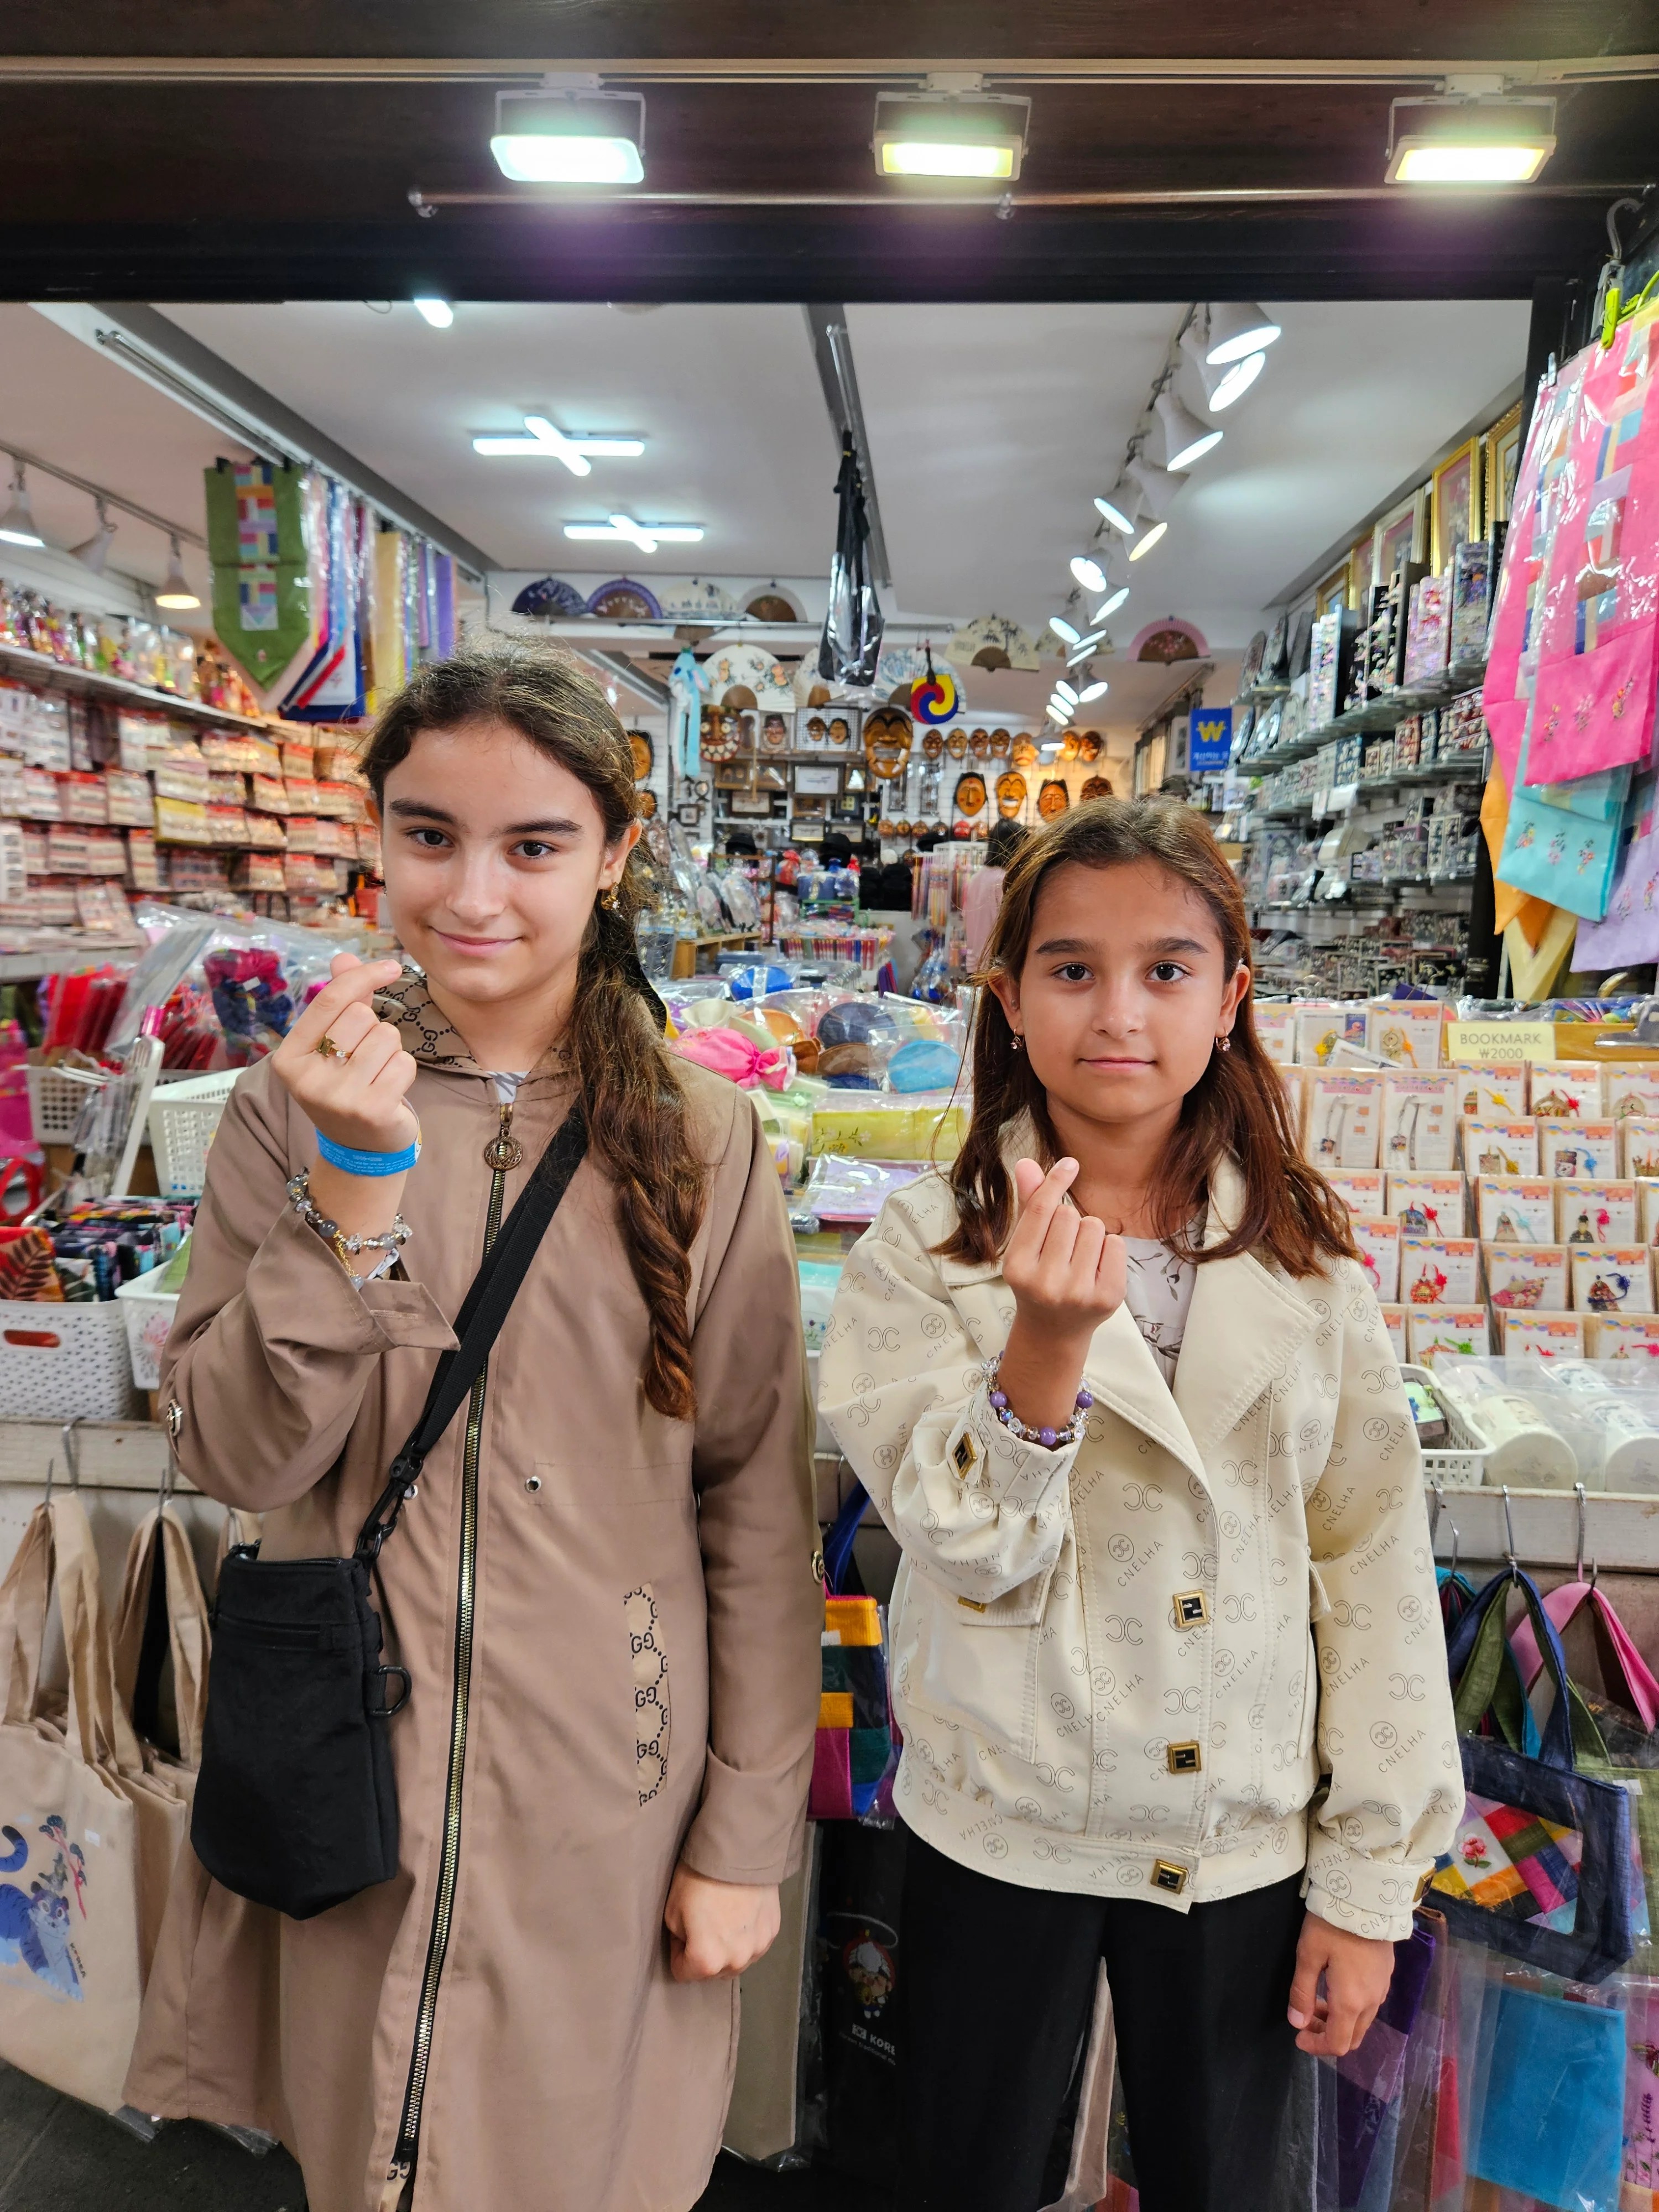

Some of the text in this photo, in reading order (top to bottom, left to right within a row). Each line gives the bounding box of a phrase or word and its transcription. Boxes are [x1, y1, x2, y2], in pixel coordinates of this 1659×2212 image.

[1460, 1033, 1542, 1045] BOOKMARK
[1379, 1414, 1412, 1461] CNELHA
[1322, 1486, 1356, 1531] CNELHA
[1117, 1541, 1164, 1587] CNELHA
[1349, 1535, 1400, 1575] CNELHA
[1216, 1650, 1259, 1699] CNELHA
[1325, 1657, 1370, 1698] CNELHA
[1096, 1674, 1145, 1723] CNELHA
[1378, 1729, 1426, 1773] CNELHA
